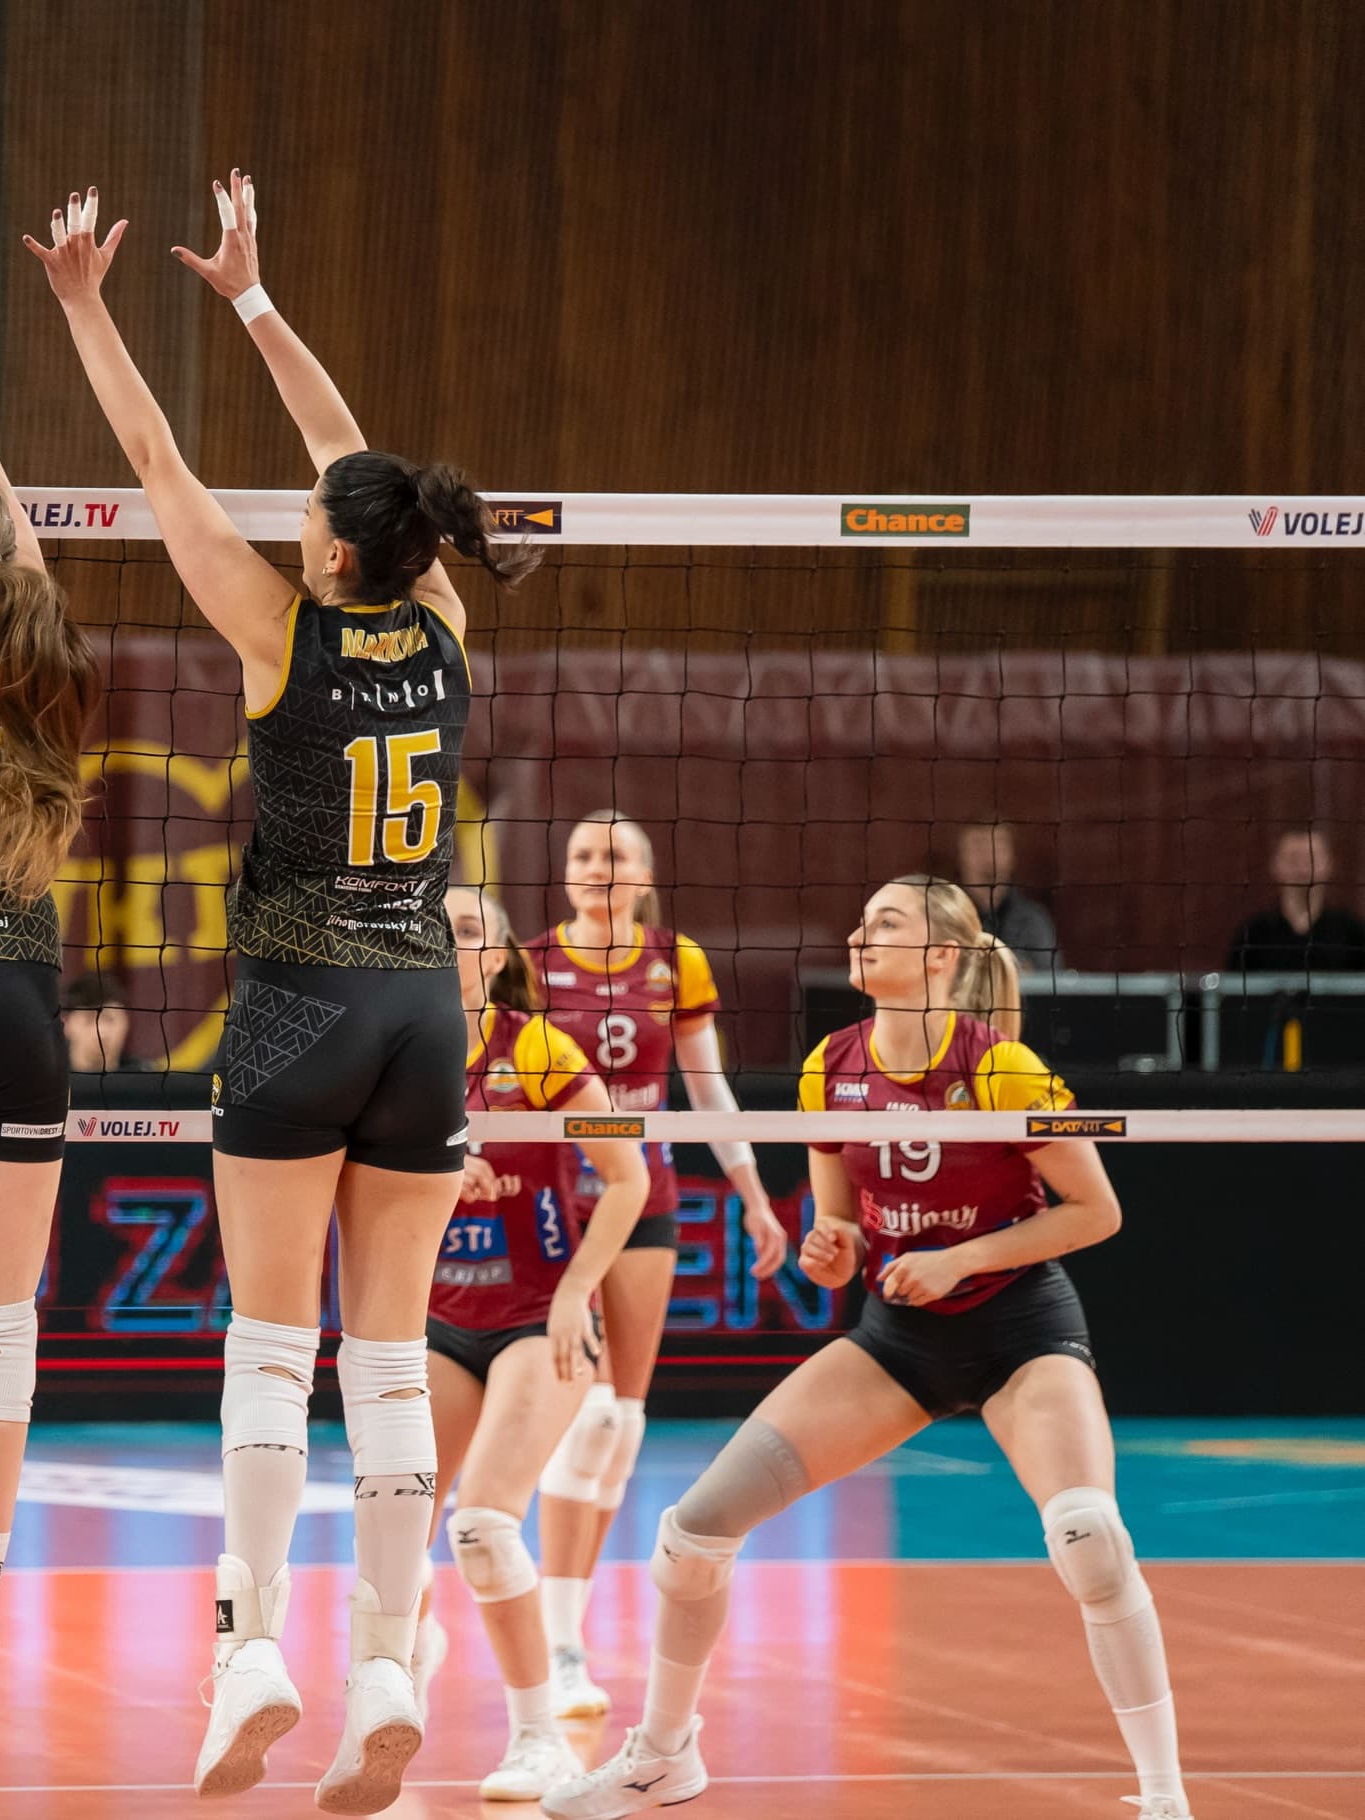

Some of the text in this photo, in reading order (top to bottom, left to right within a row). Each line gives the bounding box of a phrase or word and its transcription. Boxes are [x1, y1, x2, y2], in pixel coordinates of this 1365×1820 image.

[20, 503, 119, 527] LEJ.TV
[846, 508, 965, 532] Chance
[343, 728, 442, 866] 15
[596, 1014, 638, 1070] 8
[100, 1121, 180, 1137] VOLEJ.TV
[567, 1120, 642, 1136] Chance
[869, 1141, 942, 1183] 19
